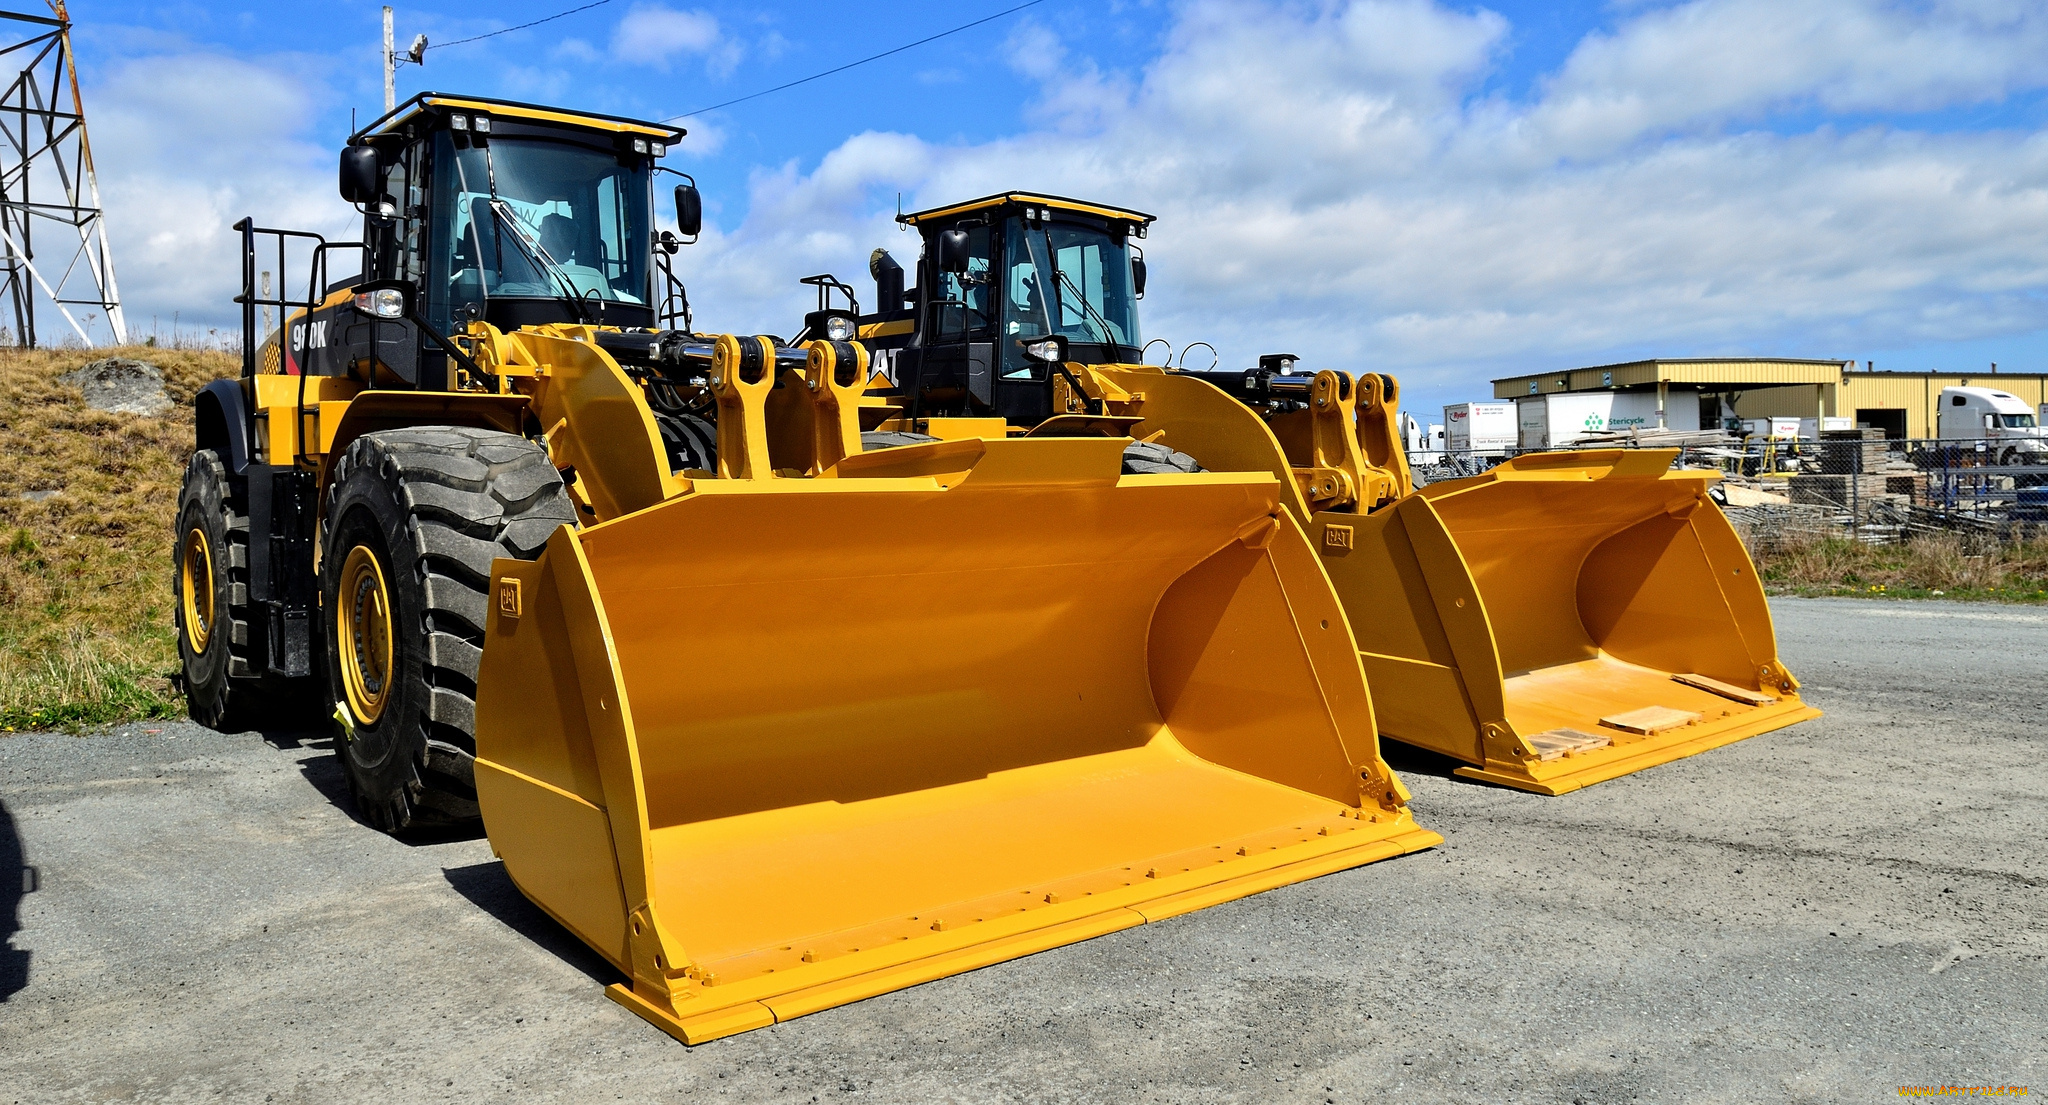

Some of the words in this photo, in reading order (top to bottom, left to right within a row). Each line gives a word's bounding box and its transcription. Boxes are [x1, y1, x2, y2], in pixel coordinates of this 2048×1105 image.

[866, 347, 904, 388] AT
[1454, 411, 1467, 419] Ryder
[1608, 416, 1645, 426] Stericycle
